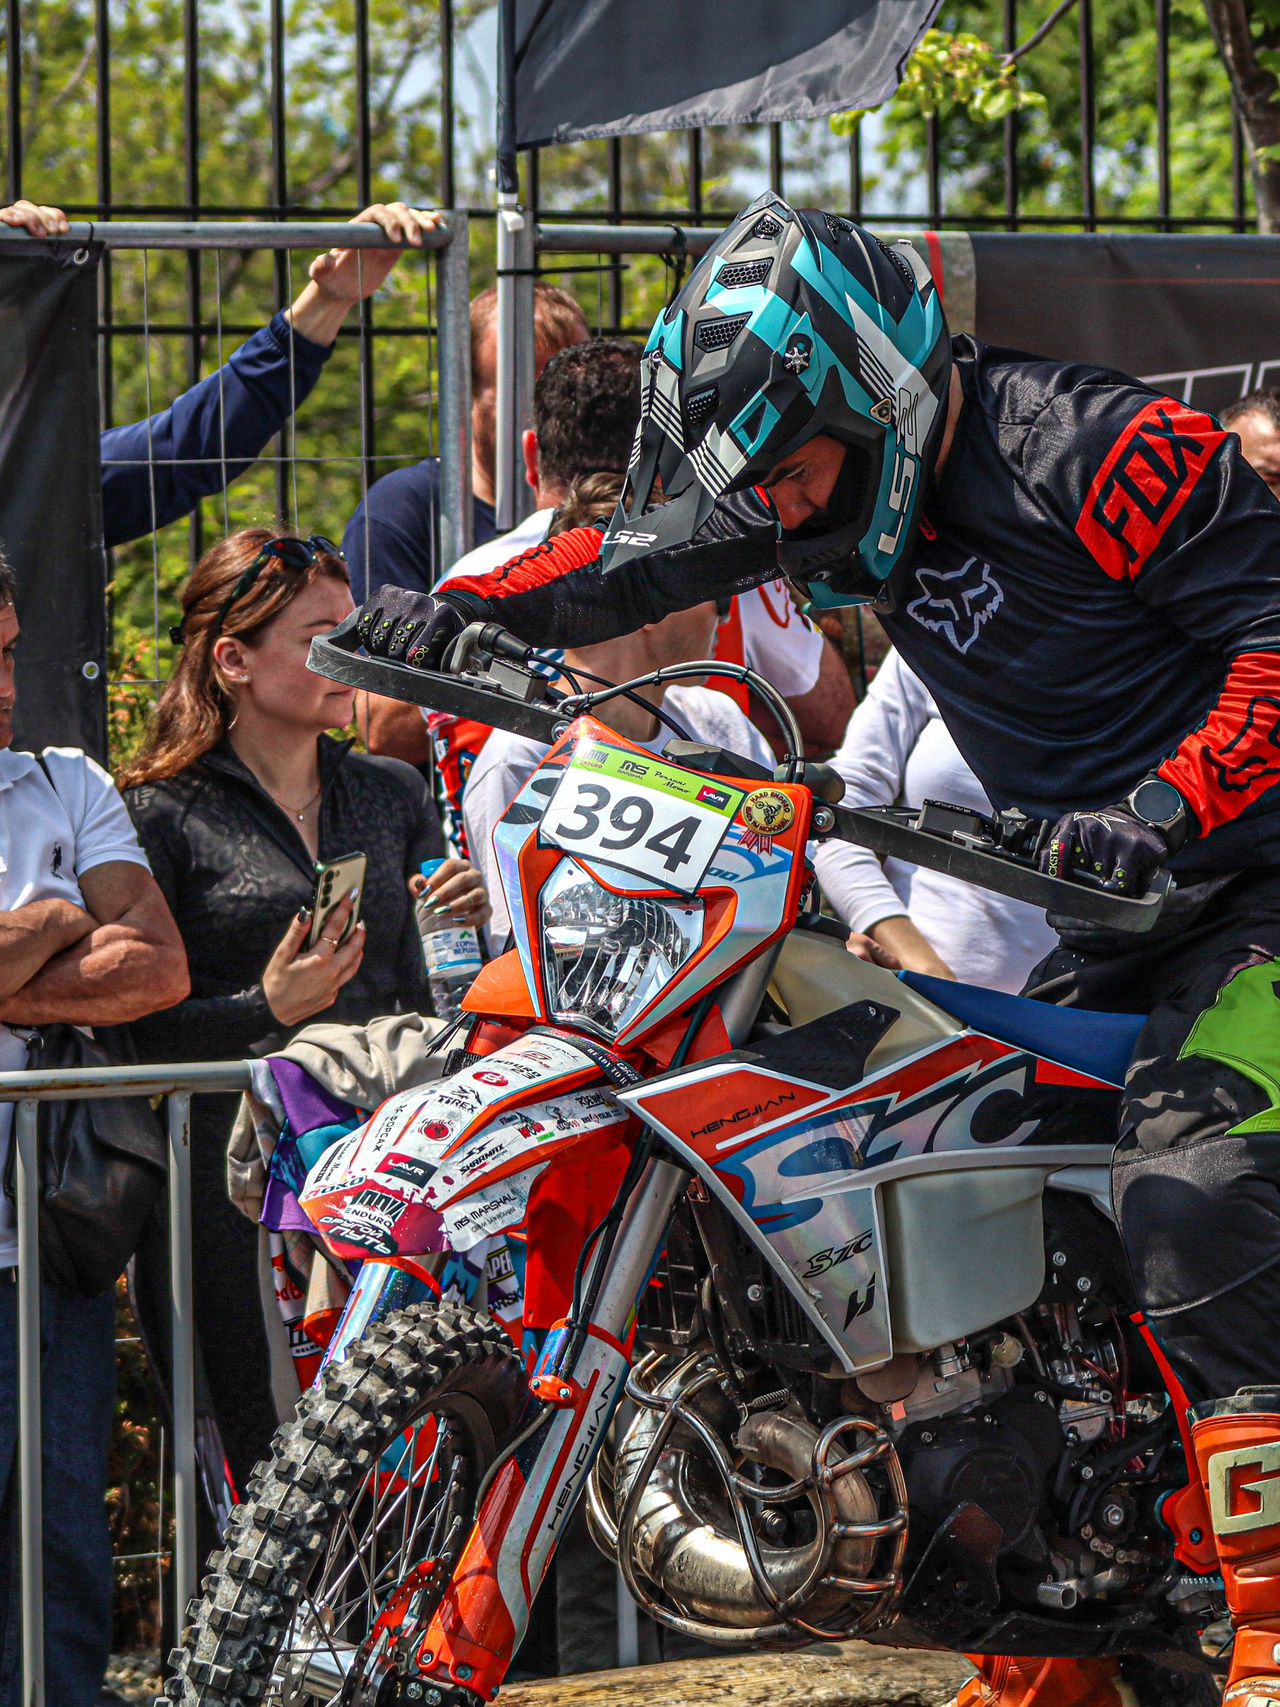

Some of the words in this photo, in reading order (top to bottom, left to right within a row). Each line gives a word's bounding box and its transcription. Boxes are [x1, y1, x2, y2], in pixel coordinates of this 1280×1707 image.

[877, 388, 920, 555] LS2
[1091, 407, 1206, 564] FOX
[601, 529, 659, 548] LS2
[702, 790, 725, 803] LAVR
[555, 782, 702, 873] 394
[690, 1092, 796, 1139] HENGJIAN
[387, 1158, 425, 1177] LAVR
[459, 1143, 505, 1175] SHARMAX
[343, 1206, 394, 1229] ENDURO
[469, 1193, 518, 1220] MARSHAL
[547, 1373, 617, 1531] HENGJIAN
